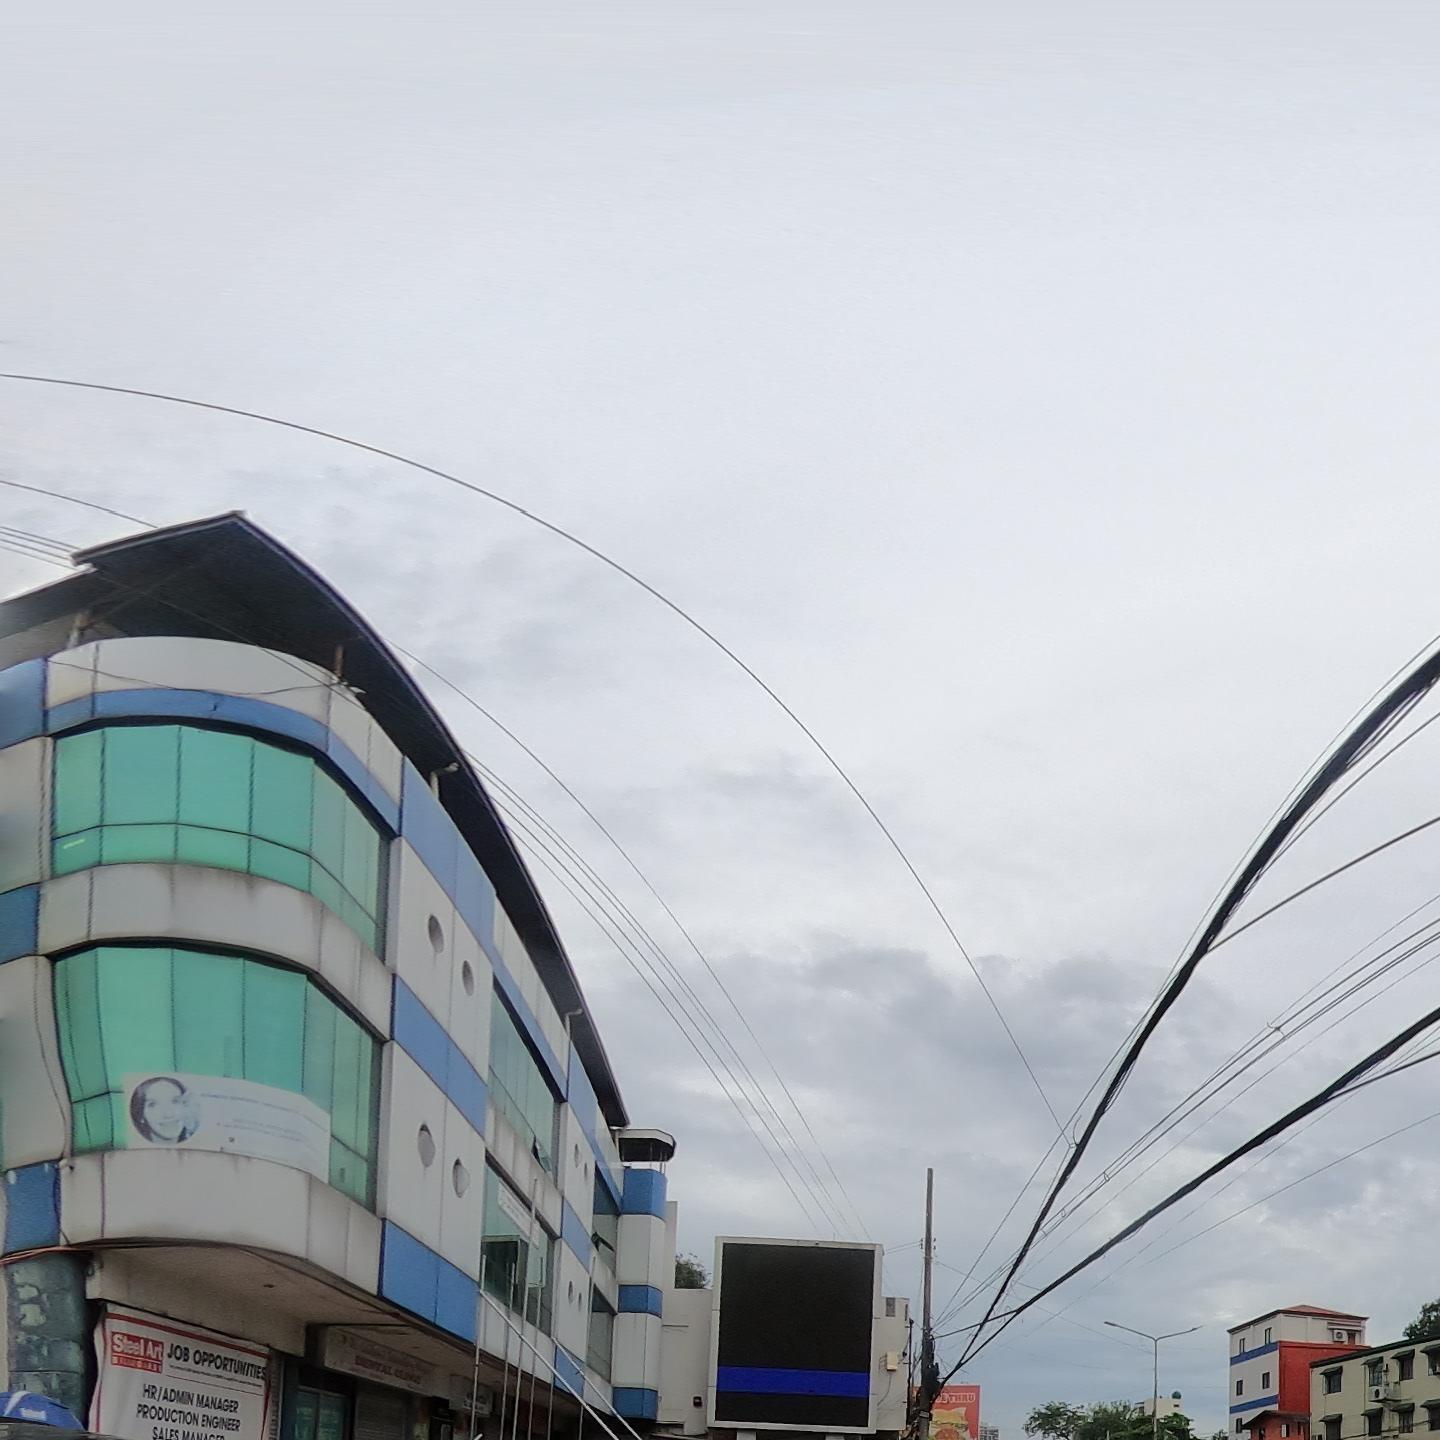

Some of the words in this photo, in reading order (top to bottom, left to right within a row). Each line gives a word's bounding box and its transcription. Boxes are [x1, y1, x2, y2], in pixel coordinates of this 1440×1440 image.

[112, 1333, 145, 1357] Steel
[145, 1340, 162, 1361] Art
[167, 1343, 189, 1363] JOB
[193, 1350, 267, 1381] OPPORTUNITIES
[143, 1383, 193, 1406] HR/ADMIN
[196, 1395, 239, 1414] MANAGER
[949, 1392, 976, 1403] THRU
[136, 1404, 200, 1426] PRODUCTION
[201, 1414, 241, 1432] ENGINEER
